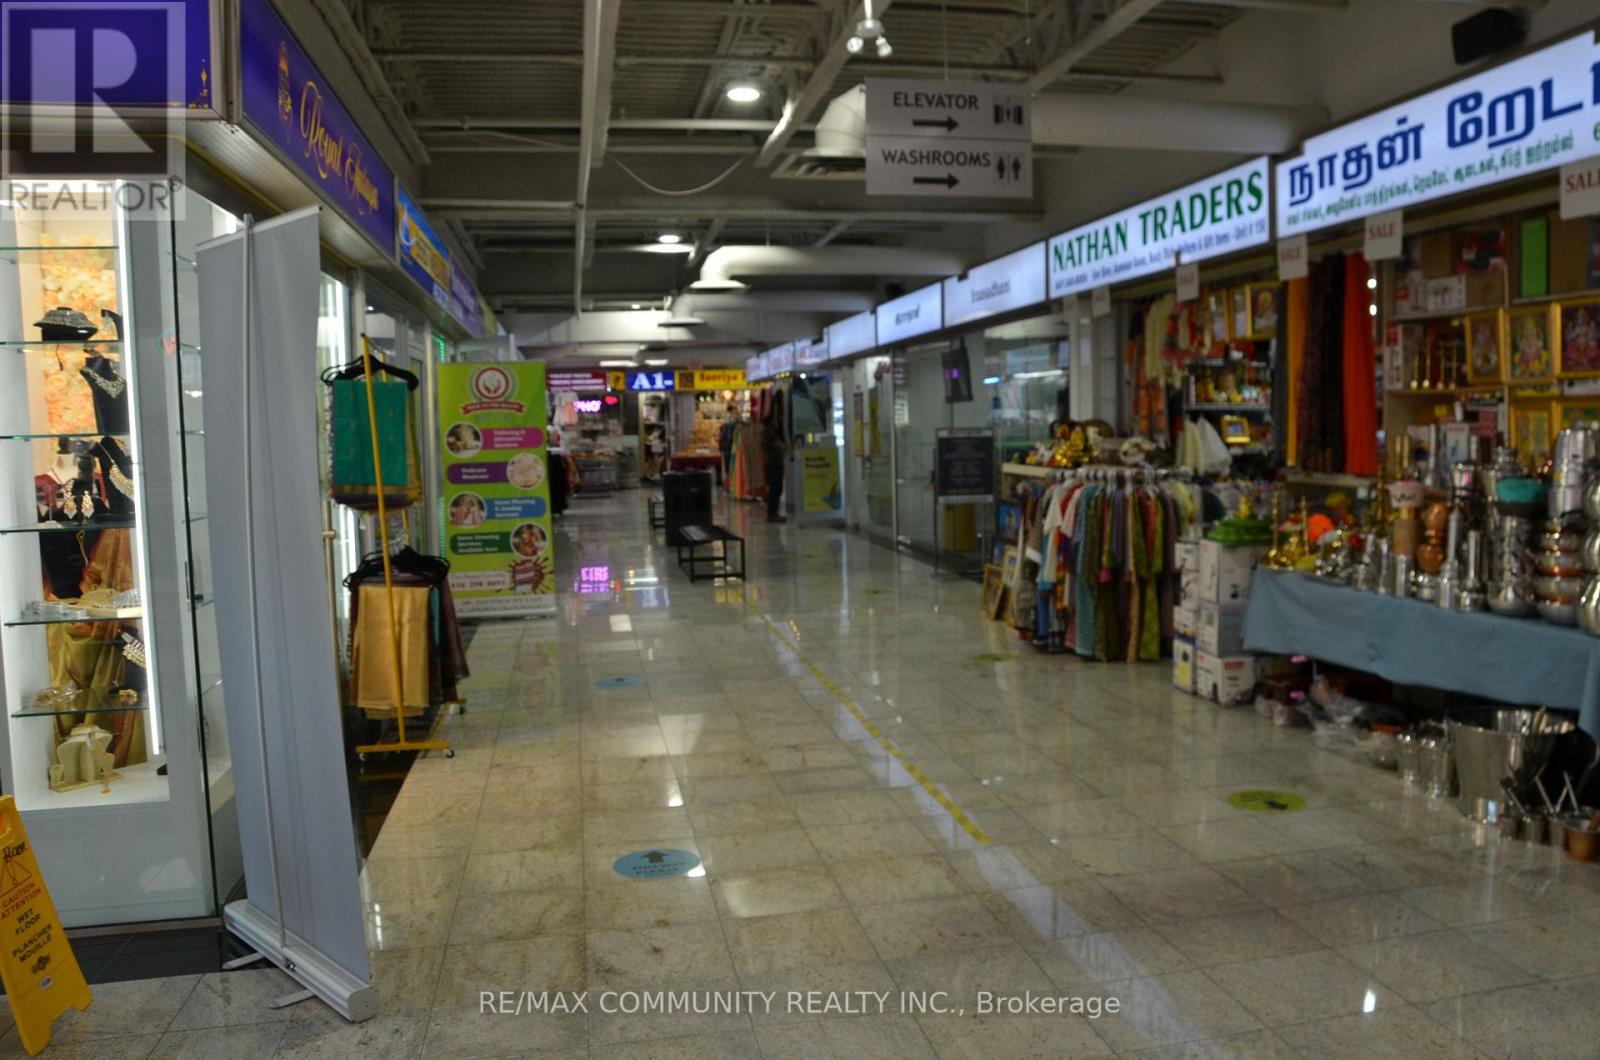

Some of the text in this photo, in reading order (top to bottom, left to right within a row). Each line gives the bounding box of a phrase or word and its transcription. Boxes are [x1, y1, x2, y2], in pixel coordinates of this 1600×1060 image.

[893, 91, 979, 110] ELEVATOR
[881, 149, 991, 167] WASHROOMS
[1053, 219, 1129, 274] NATHAN
[1139, 169, 1263, 246] TRADERS
[1369, 222, 1396, 241] SALE
[0, 887, 42, 920] ATTENTION
[2, 882, 36, 909] CAUTION
[15, 913, 42, 936] FLOOR
[17, 907, 34, 923] WET
